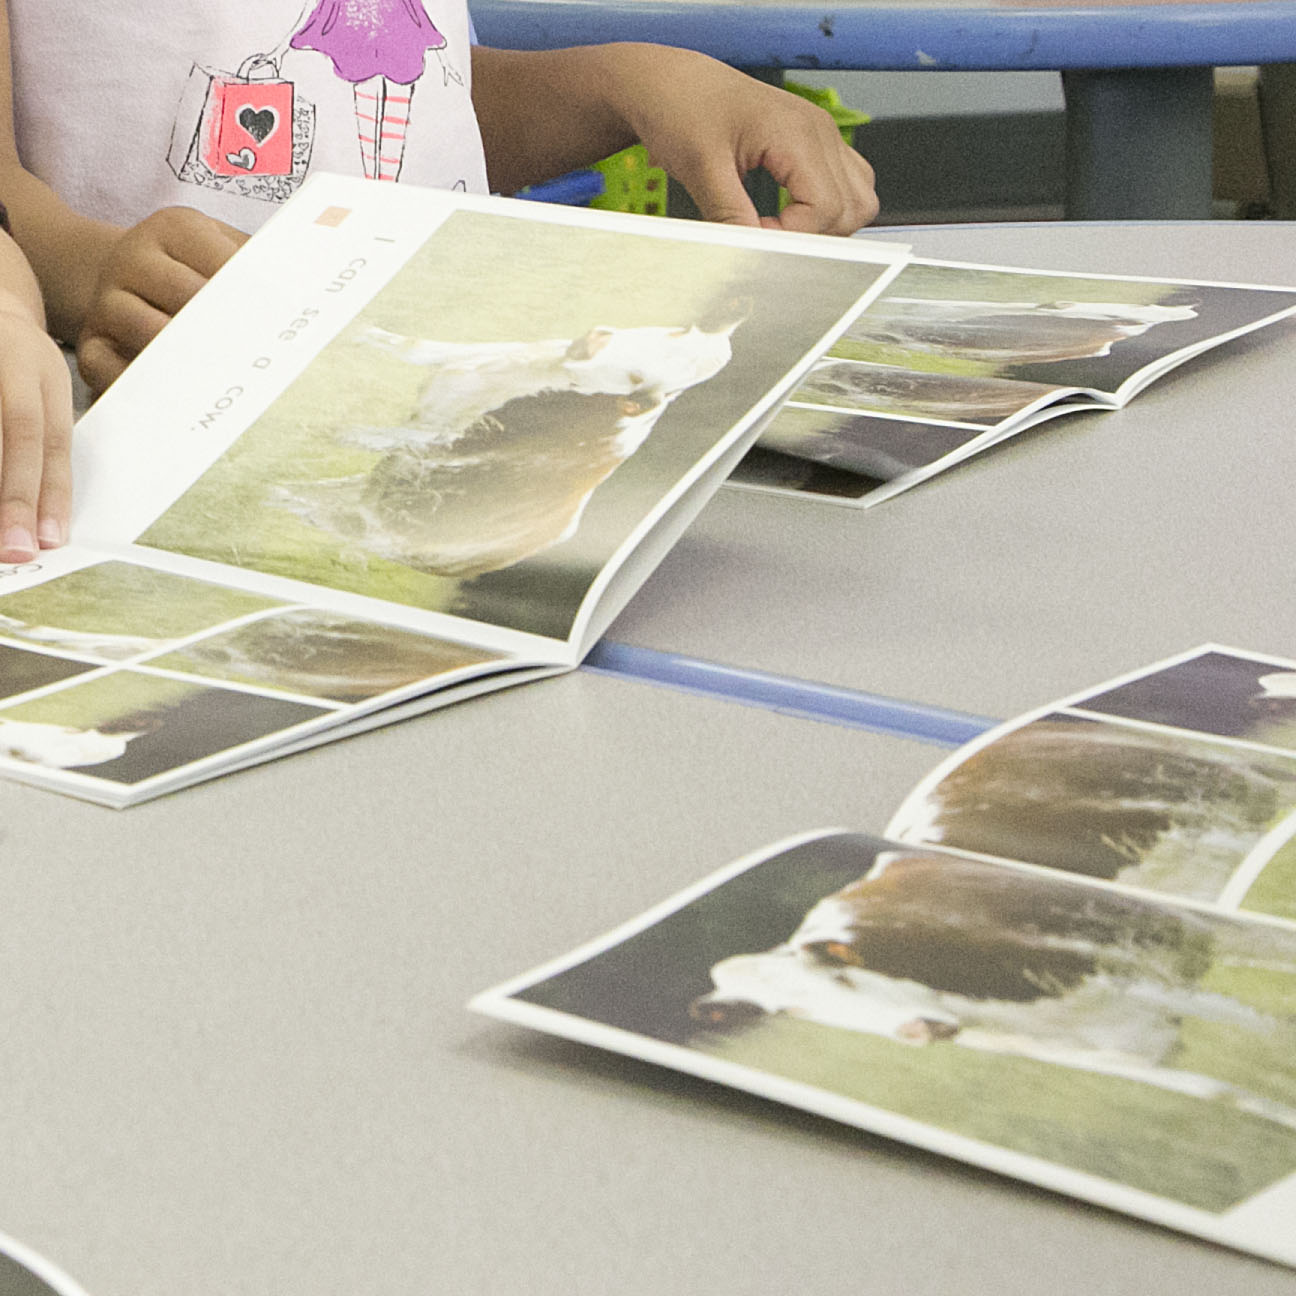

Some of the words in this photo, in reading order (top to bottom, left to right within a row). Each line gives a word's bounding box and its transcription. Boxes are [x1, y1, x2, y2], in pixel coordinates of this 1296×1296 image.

[325, 257, 367, 293] can
[278, 307, 320, 341] see
[252, 357, 271, 370] a
[191, 385, 244, 430] cow.
